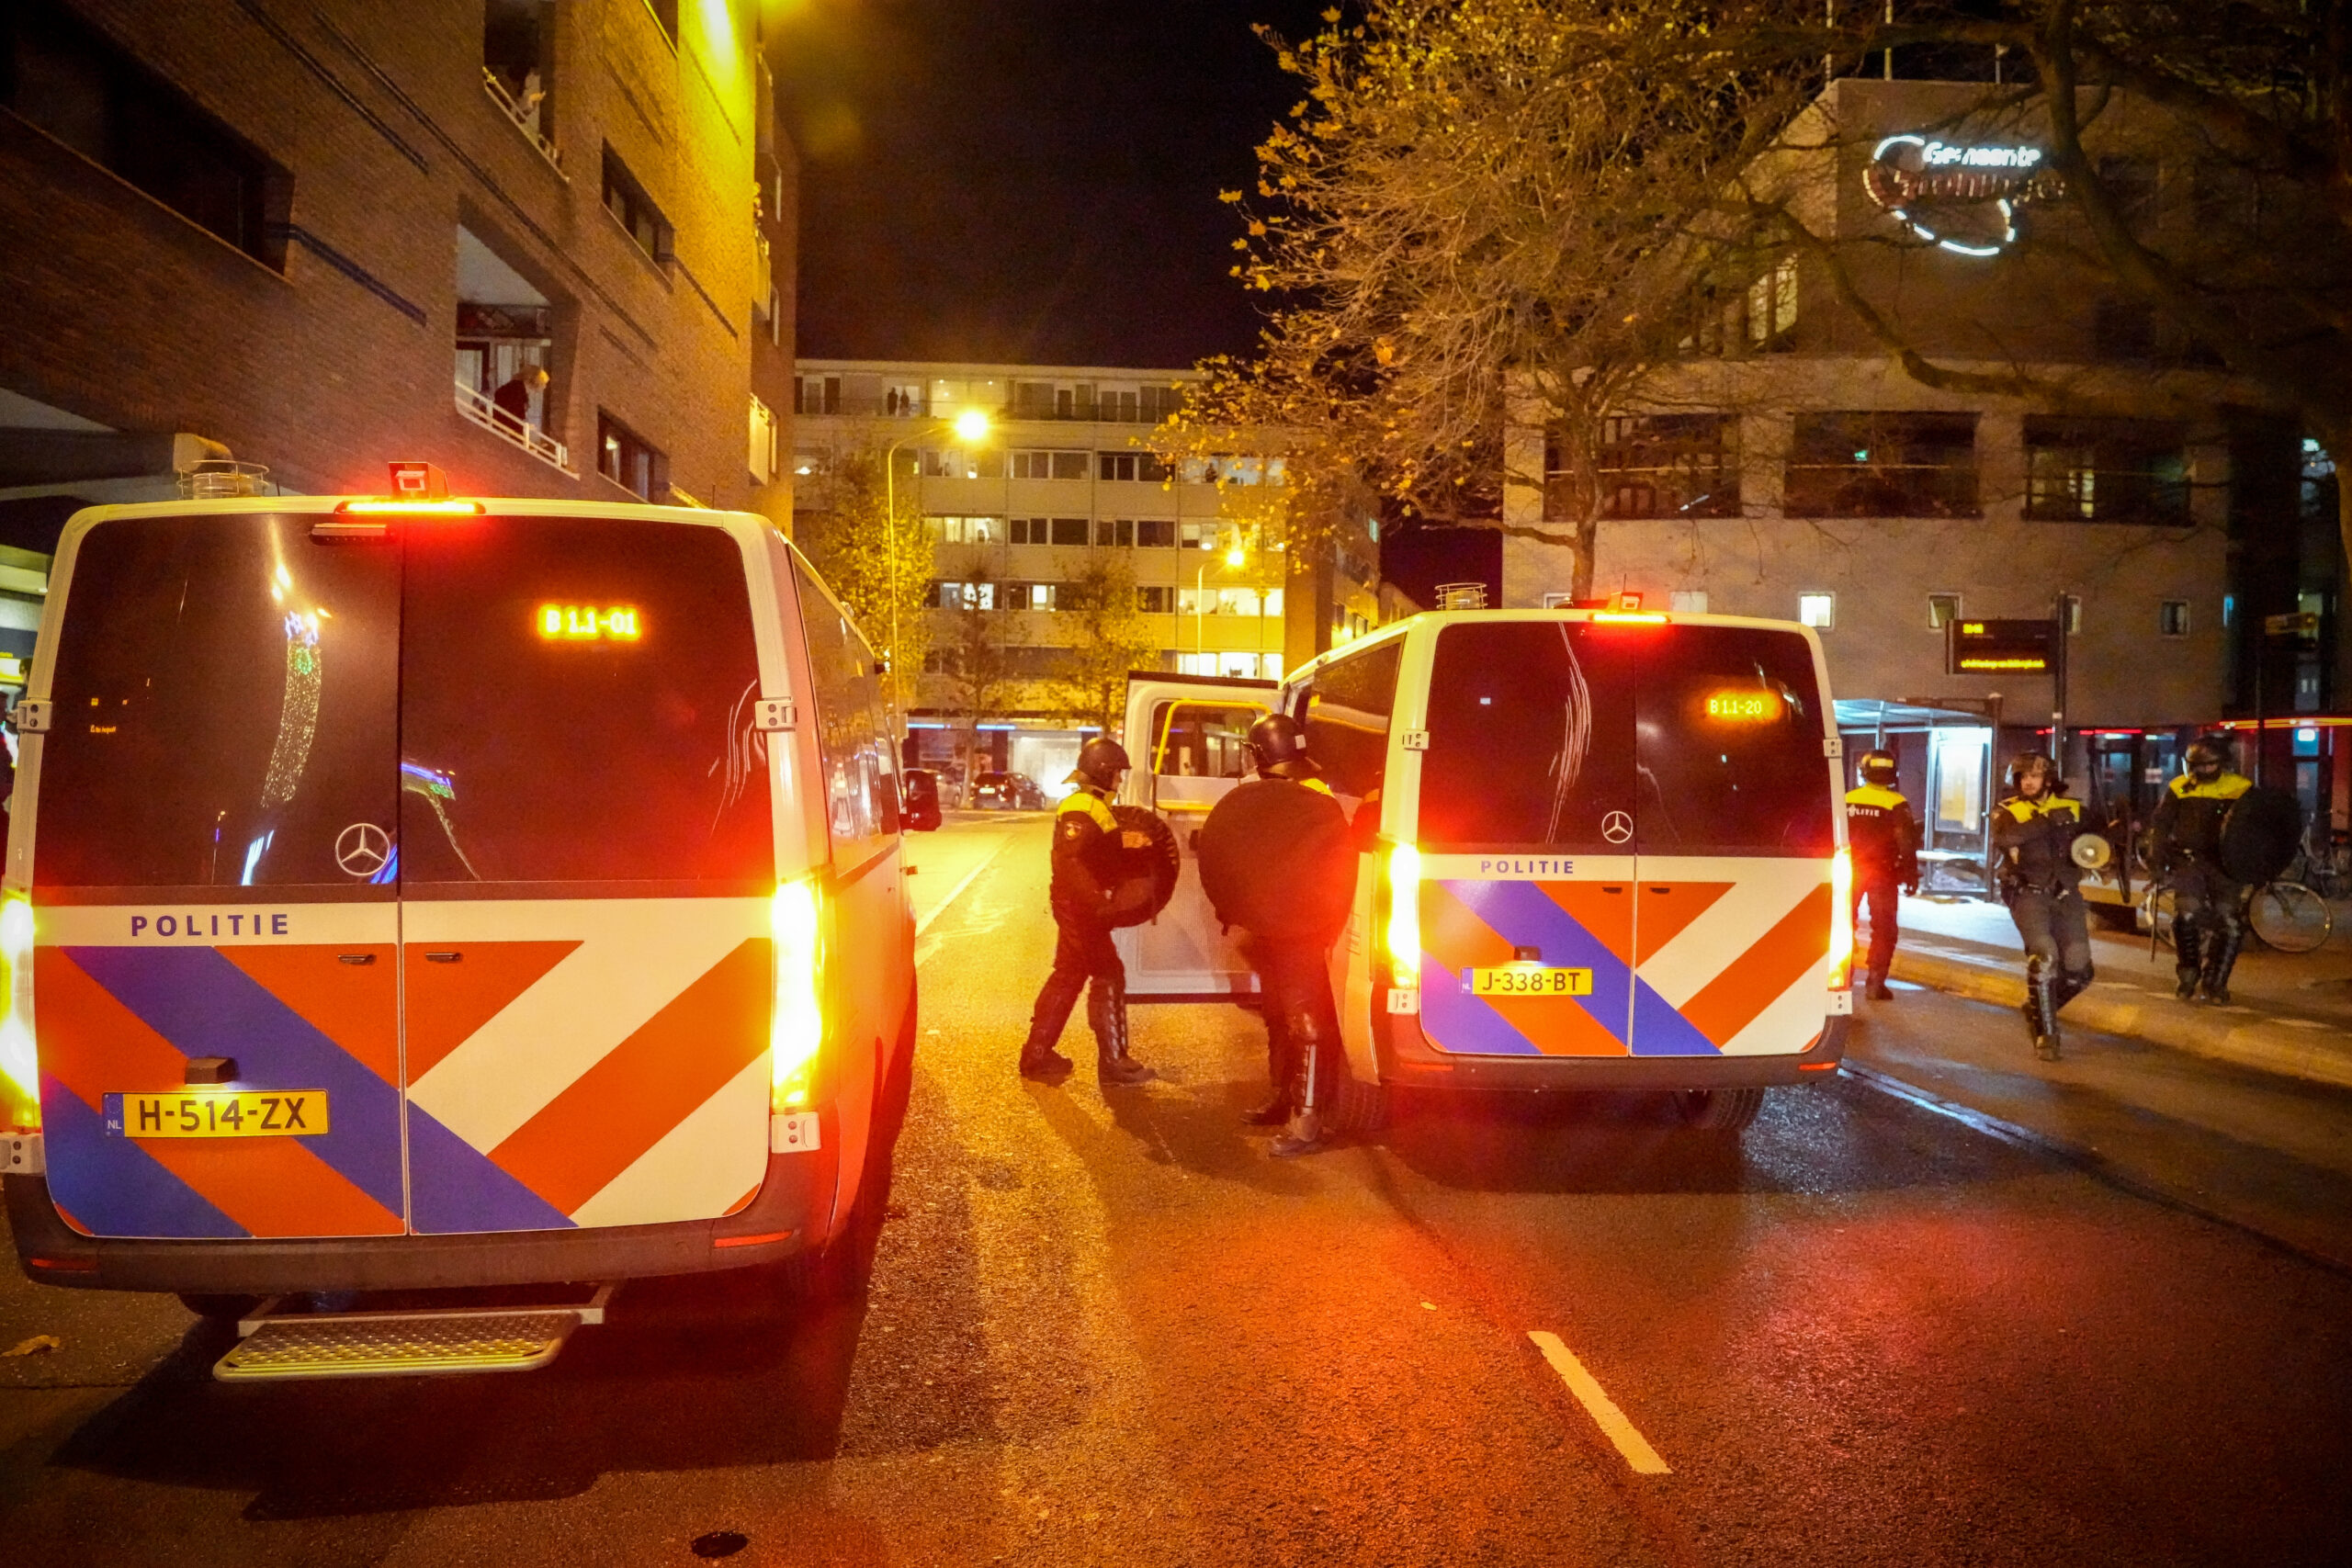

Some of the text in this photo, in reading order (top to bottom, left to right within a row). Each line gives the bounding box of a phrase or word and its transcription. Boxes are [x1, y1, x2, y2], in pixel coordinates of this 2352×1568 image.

[542, 606, 561, 636] B
[1709, 698, 1762, 715] B 1.1-20
[1847, 804, 1880, 818] LITIE
[1480, 860, 1574, 874] POLITIE
[130, 913, 288, 937] POLITIE
[1462, 971, 1581, 992] NL J-338-BT
[107, 1097, 307, 1132] NL H-514-ZX
